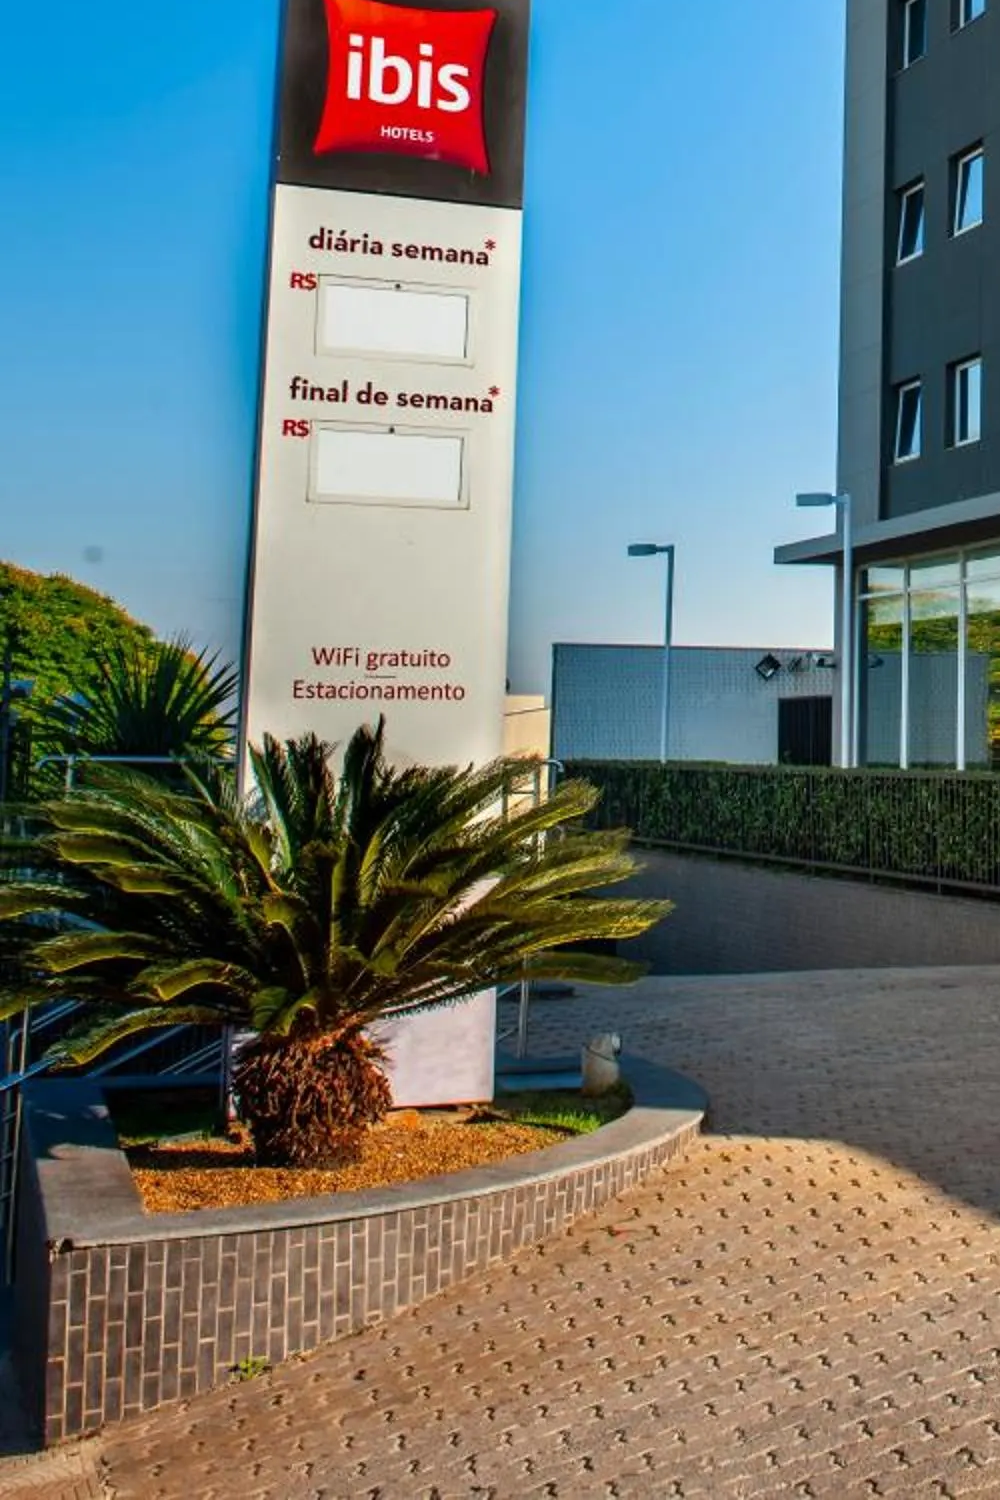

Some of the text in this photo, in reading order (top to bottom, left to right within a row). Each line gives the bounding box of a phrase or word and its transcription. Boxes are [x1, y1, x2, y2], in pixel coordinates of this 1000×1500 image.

[346, 33, 472, 113] ibis
[380, 125, 435, 143] HOTELS
[308, 227, 384, 257] diária
[290, 272, 318, 291] R$
[289, 376, 348, 404] final
[357, 382, 389, 406] de
[282, 419, 310, 438] R$
[312, 647, 451, 671] WiFi gratuito
[293, 679, 465, 701] Estacionamento
